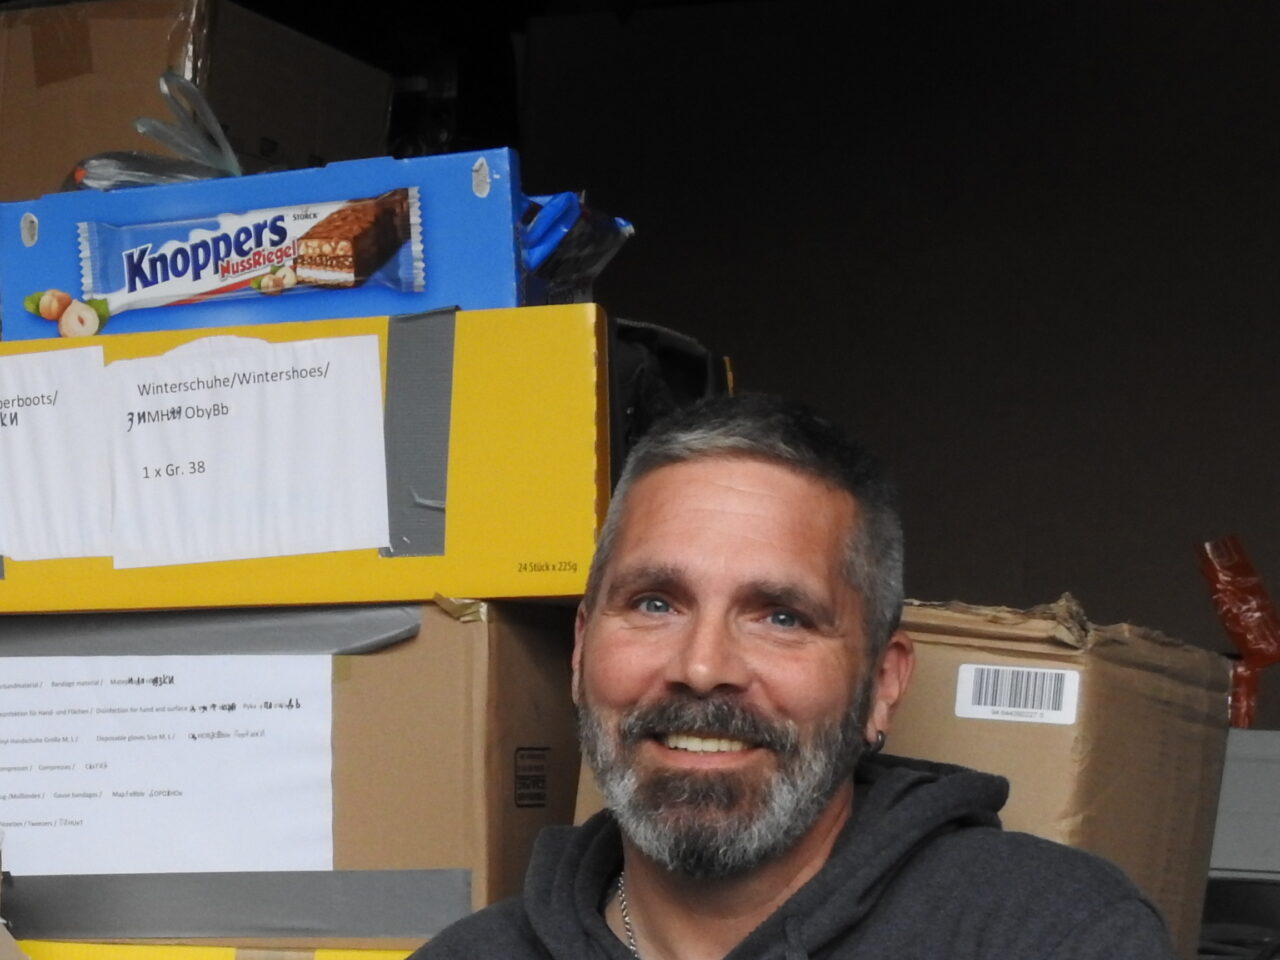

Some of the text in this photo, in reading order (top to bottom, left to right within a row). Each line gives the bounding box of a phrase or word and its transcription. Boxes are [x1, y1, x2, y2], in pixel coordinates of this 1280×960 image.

[125, 213, 288, 294] Knoppers
[220, 239, 298, 279] NussRiegel
[137, 361, 330, 396] Winterschuhe/Wintershoes/
[143, 460, 206, 479] 1 x Gr. 38
[517, 562, 528, 573] 24
[528, 561, 550, 573] Stück
[558, 561, 578, 574] 225g
